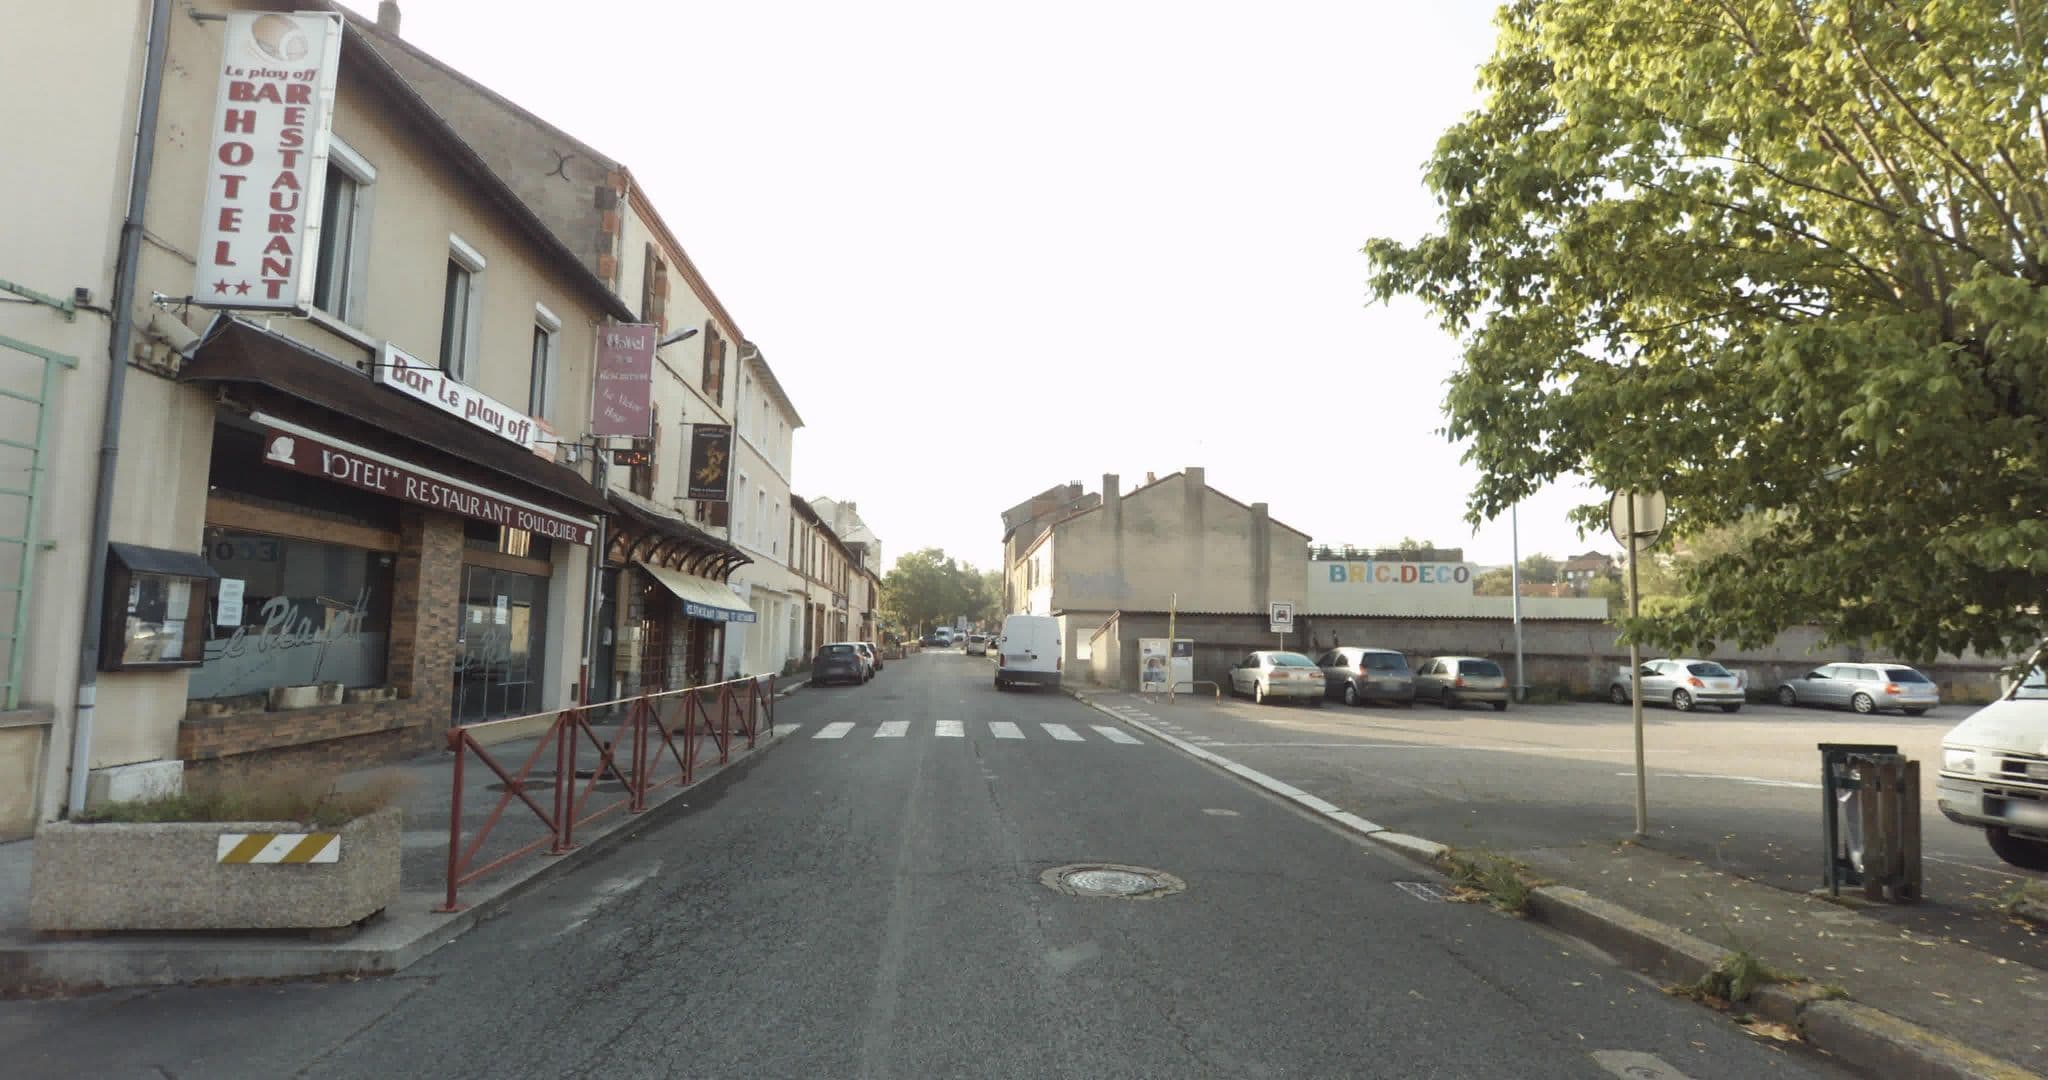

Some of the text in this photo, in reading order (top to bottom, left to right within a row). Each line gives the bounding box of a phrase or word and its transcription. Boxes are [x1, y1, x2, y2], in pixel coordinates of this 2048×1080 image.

[225, 65, 318, 81] Le play off
[228, 81, 311, 104] BAR
[214, 109, 256, 266] HOTEL
[260, 84, 311, 299] RESTAURANT
[392, 355, 531, 444] Bar Le play off
[405, 477, 512, 524] RESTAURANT
[518, 511, 577, 542] FOULQUIER
